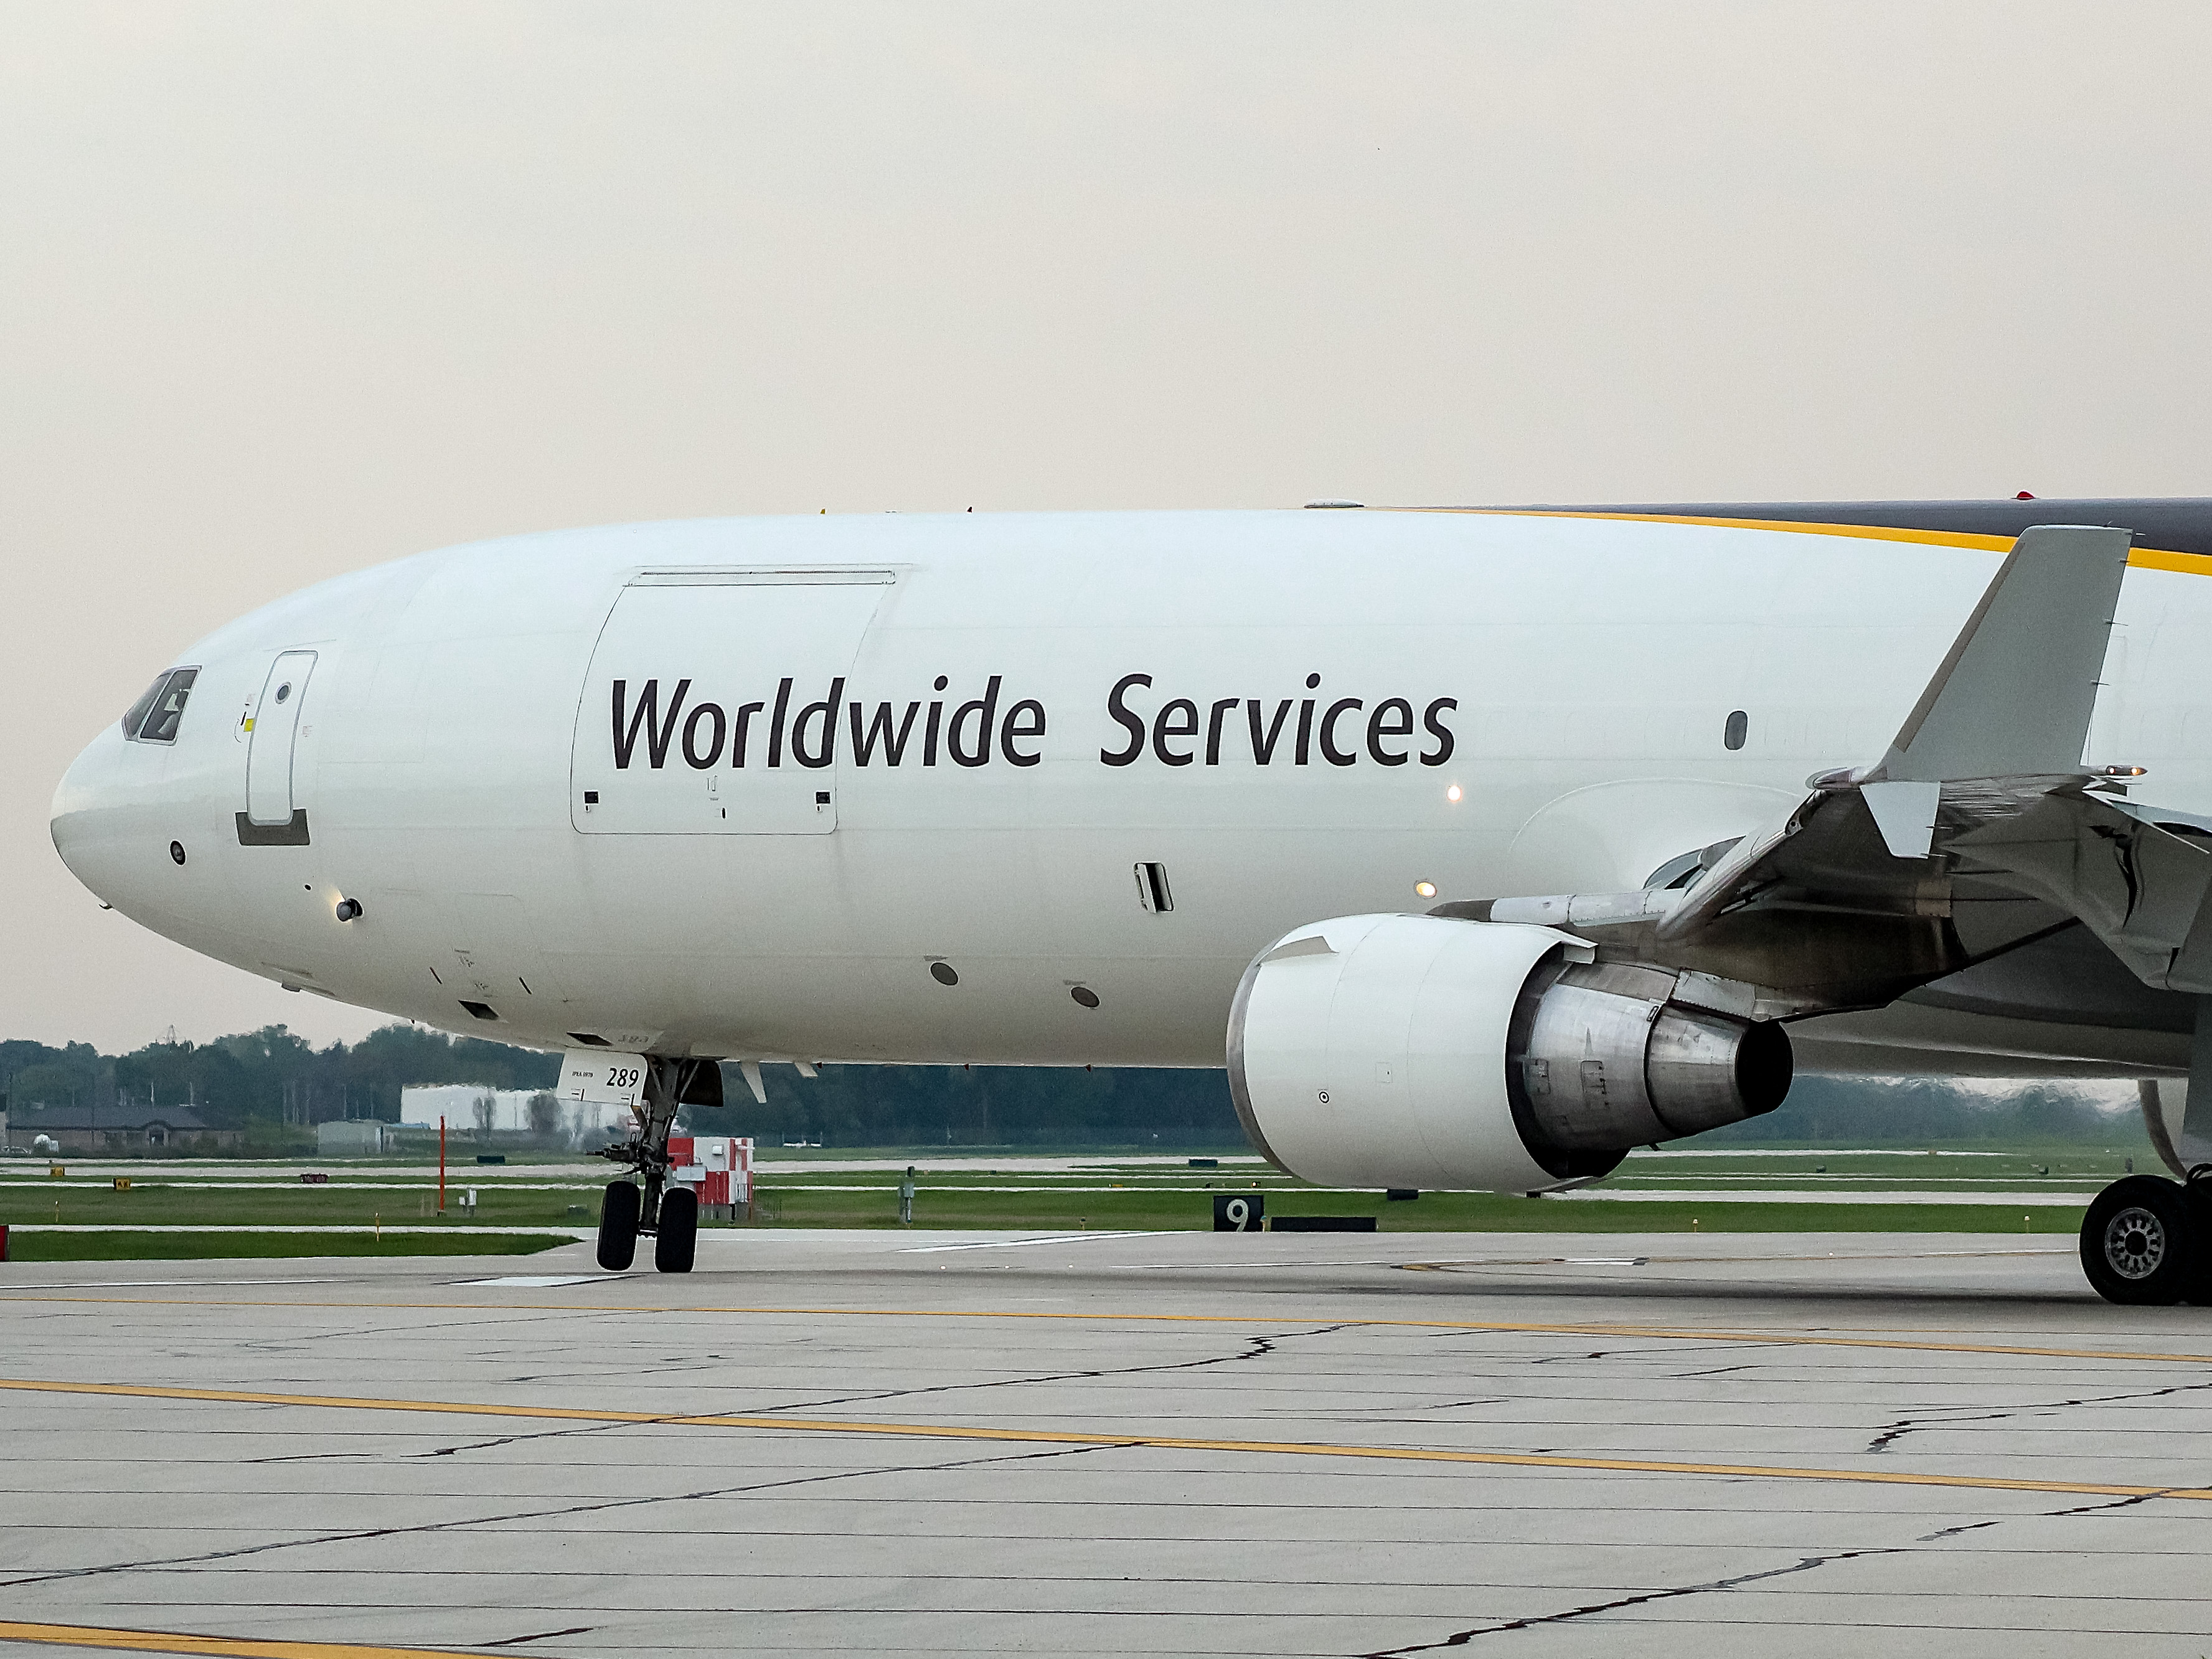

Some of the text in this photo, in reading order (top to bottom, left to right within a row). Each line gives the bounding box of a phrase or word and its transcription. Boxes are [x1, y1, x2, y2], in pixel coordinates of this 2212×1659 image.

[612, 672, 1458, 770] Worldwide Services
[606, 1067, 639, 1088] 289
[1226, 1199, 1249, 1232] 9
